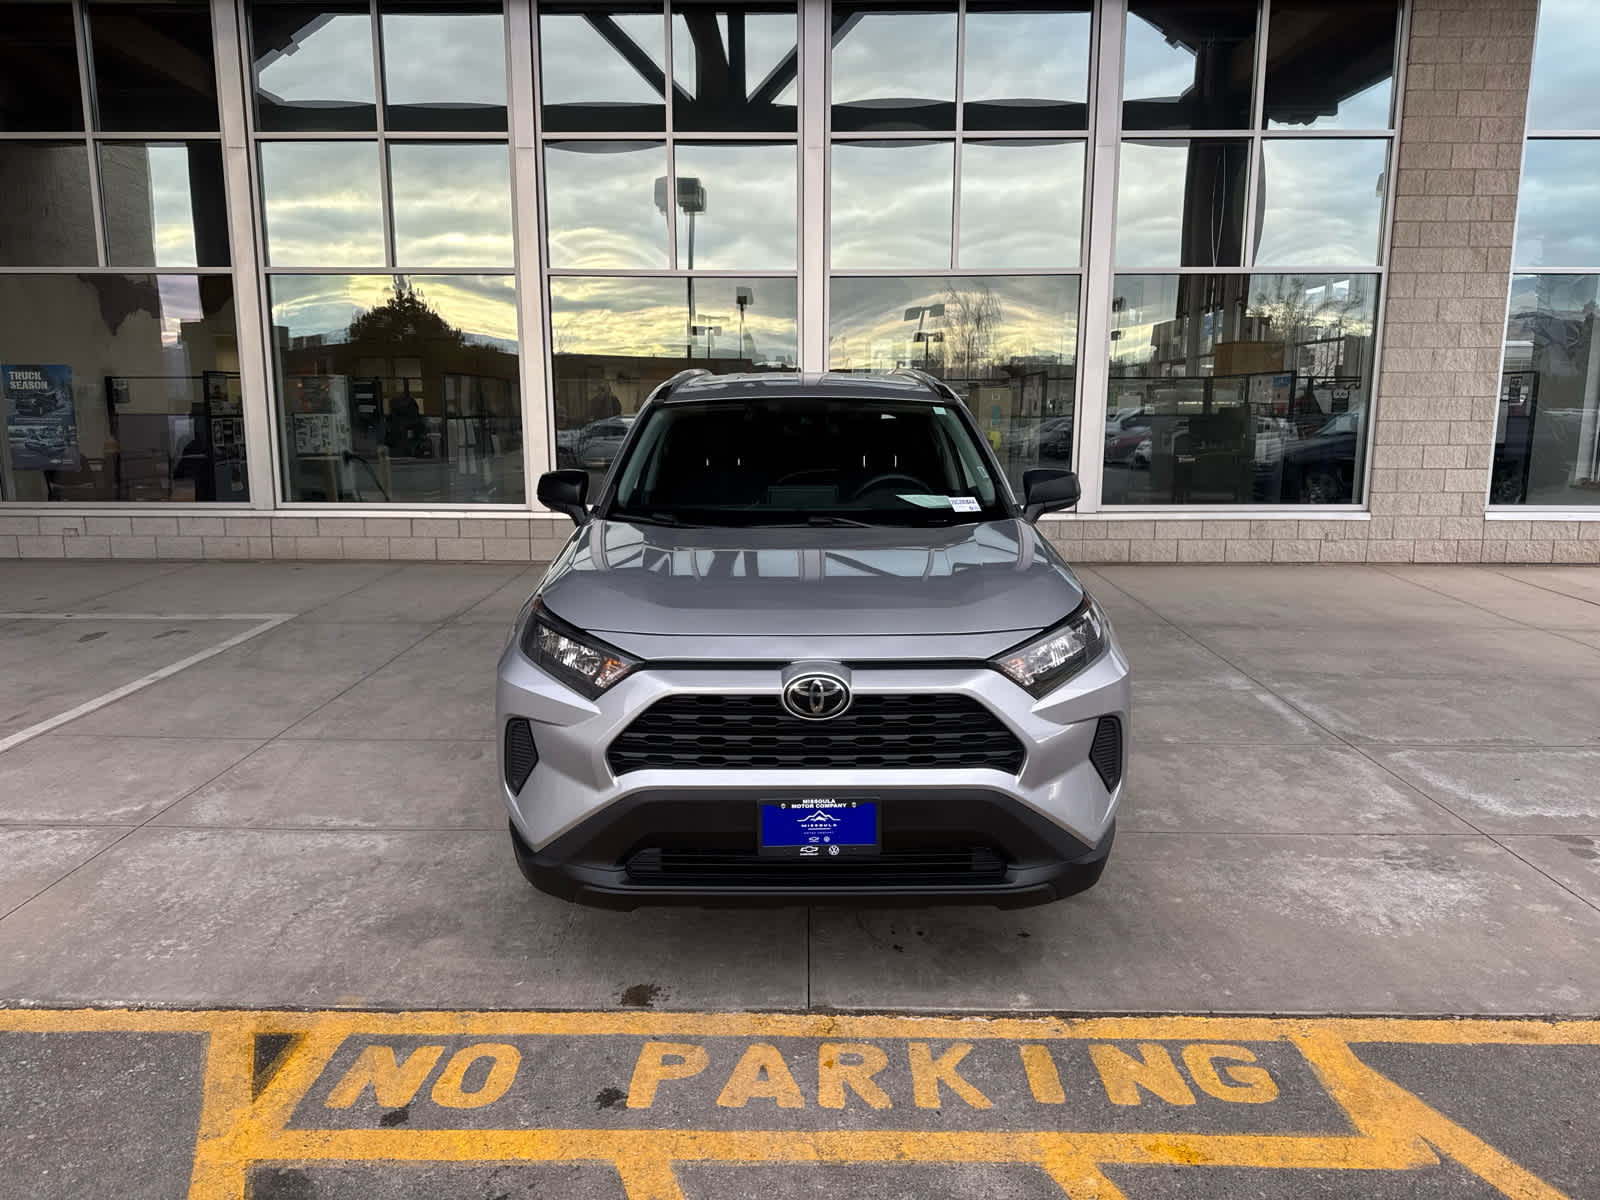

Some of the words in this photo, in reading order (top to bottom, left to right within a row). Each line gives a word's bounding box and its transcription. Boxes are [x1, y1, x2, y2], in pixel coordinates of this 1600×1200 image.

[8, 371, 42, 380] TRUCK
[9, 381, 48, 390] SEASON
[324, 1042, 522, 1109] NO
[625, 1041, 1280, 1110] PARKING
